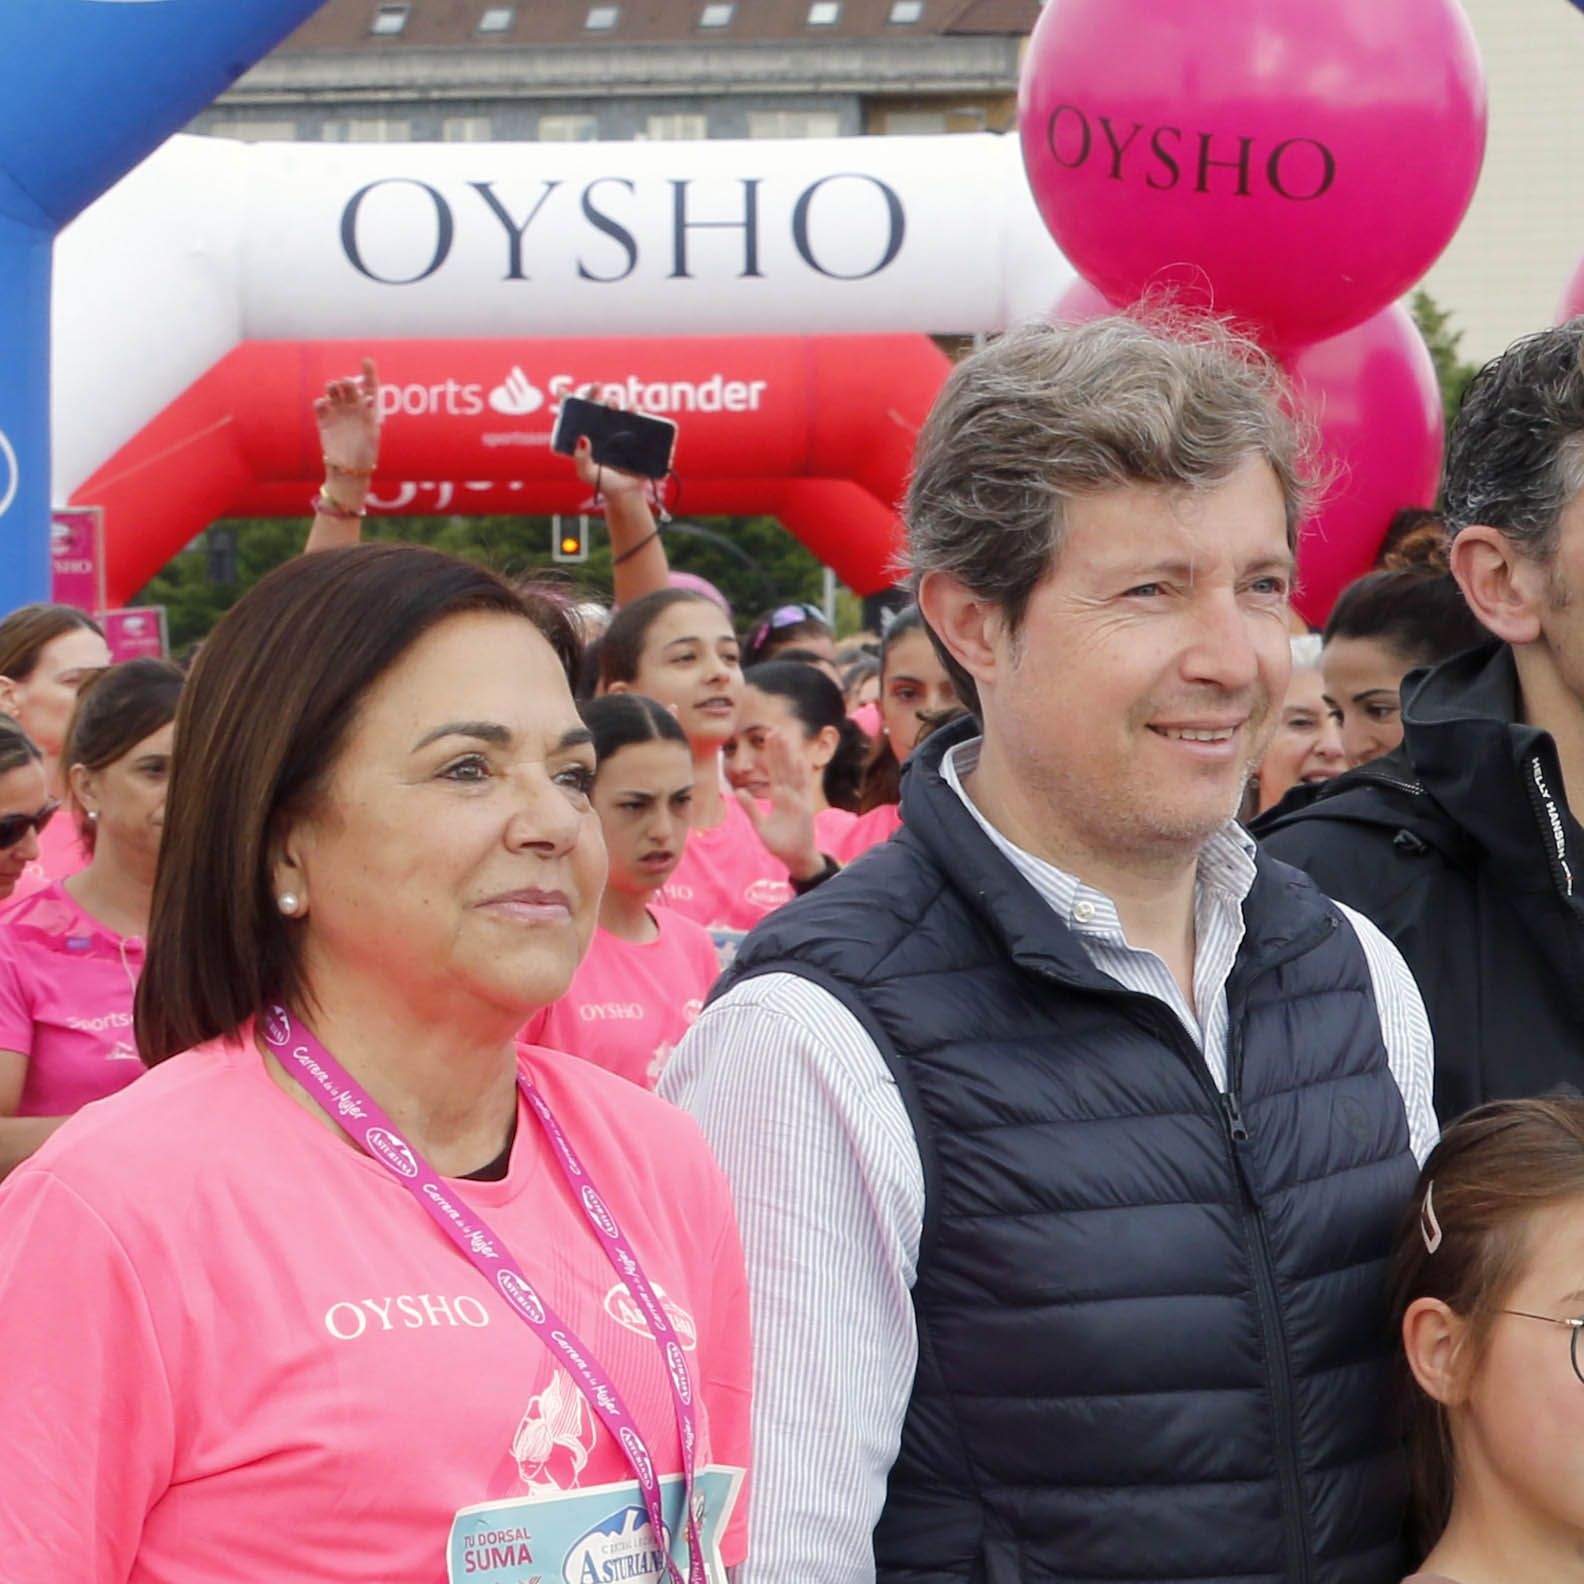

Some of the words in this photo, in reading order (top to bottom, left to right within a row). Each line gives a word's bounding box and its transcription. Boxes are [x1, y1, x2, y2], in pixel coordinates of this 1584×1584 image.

[1047, 104, 1336, 201] OYSHO
[340, 173, 906, 285] OYSHO
[350, 374, 483, 424] ports
[1531, 757, 1552, 799] HELLY
[1546, 801, 1567, 860] HANSEN
[579, 1002, 645, 1021] OYSHO
[325, 1294, 490, 1341] OYSHO
[464, 1543, 533, 1574] SUMA
[477, 1527, 532, 1547] DORSAL
